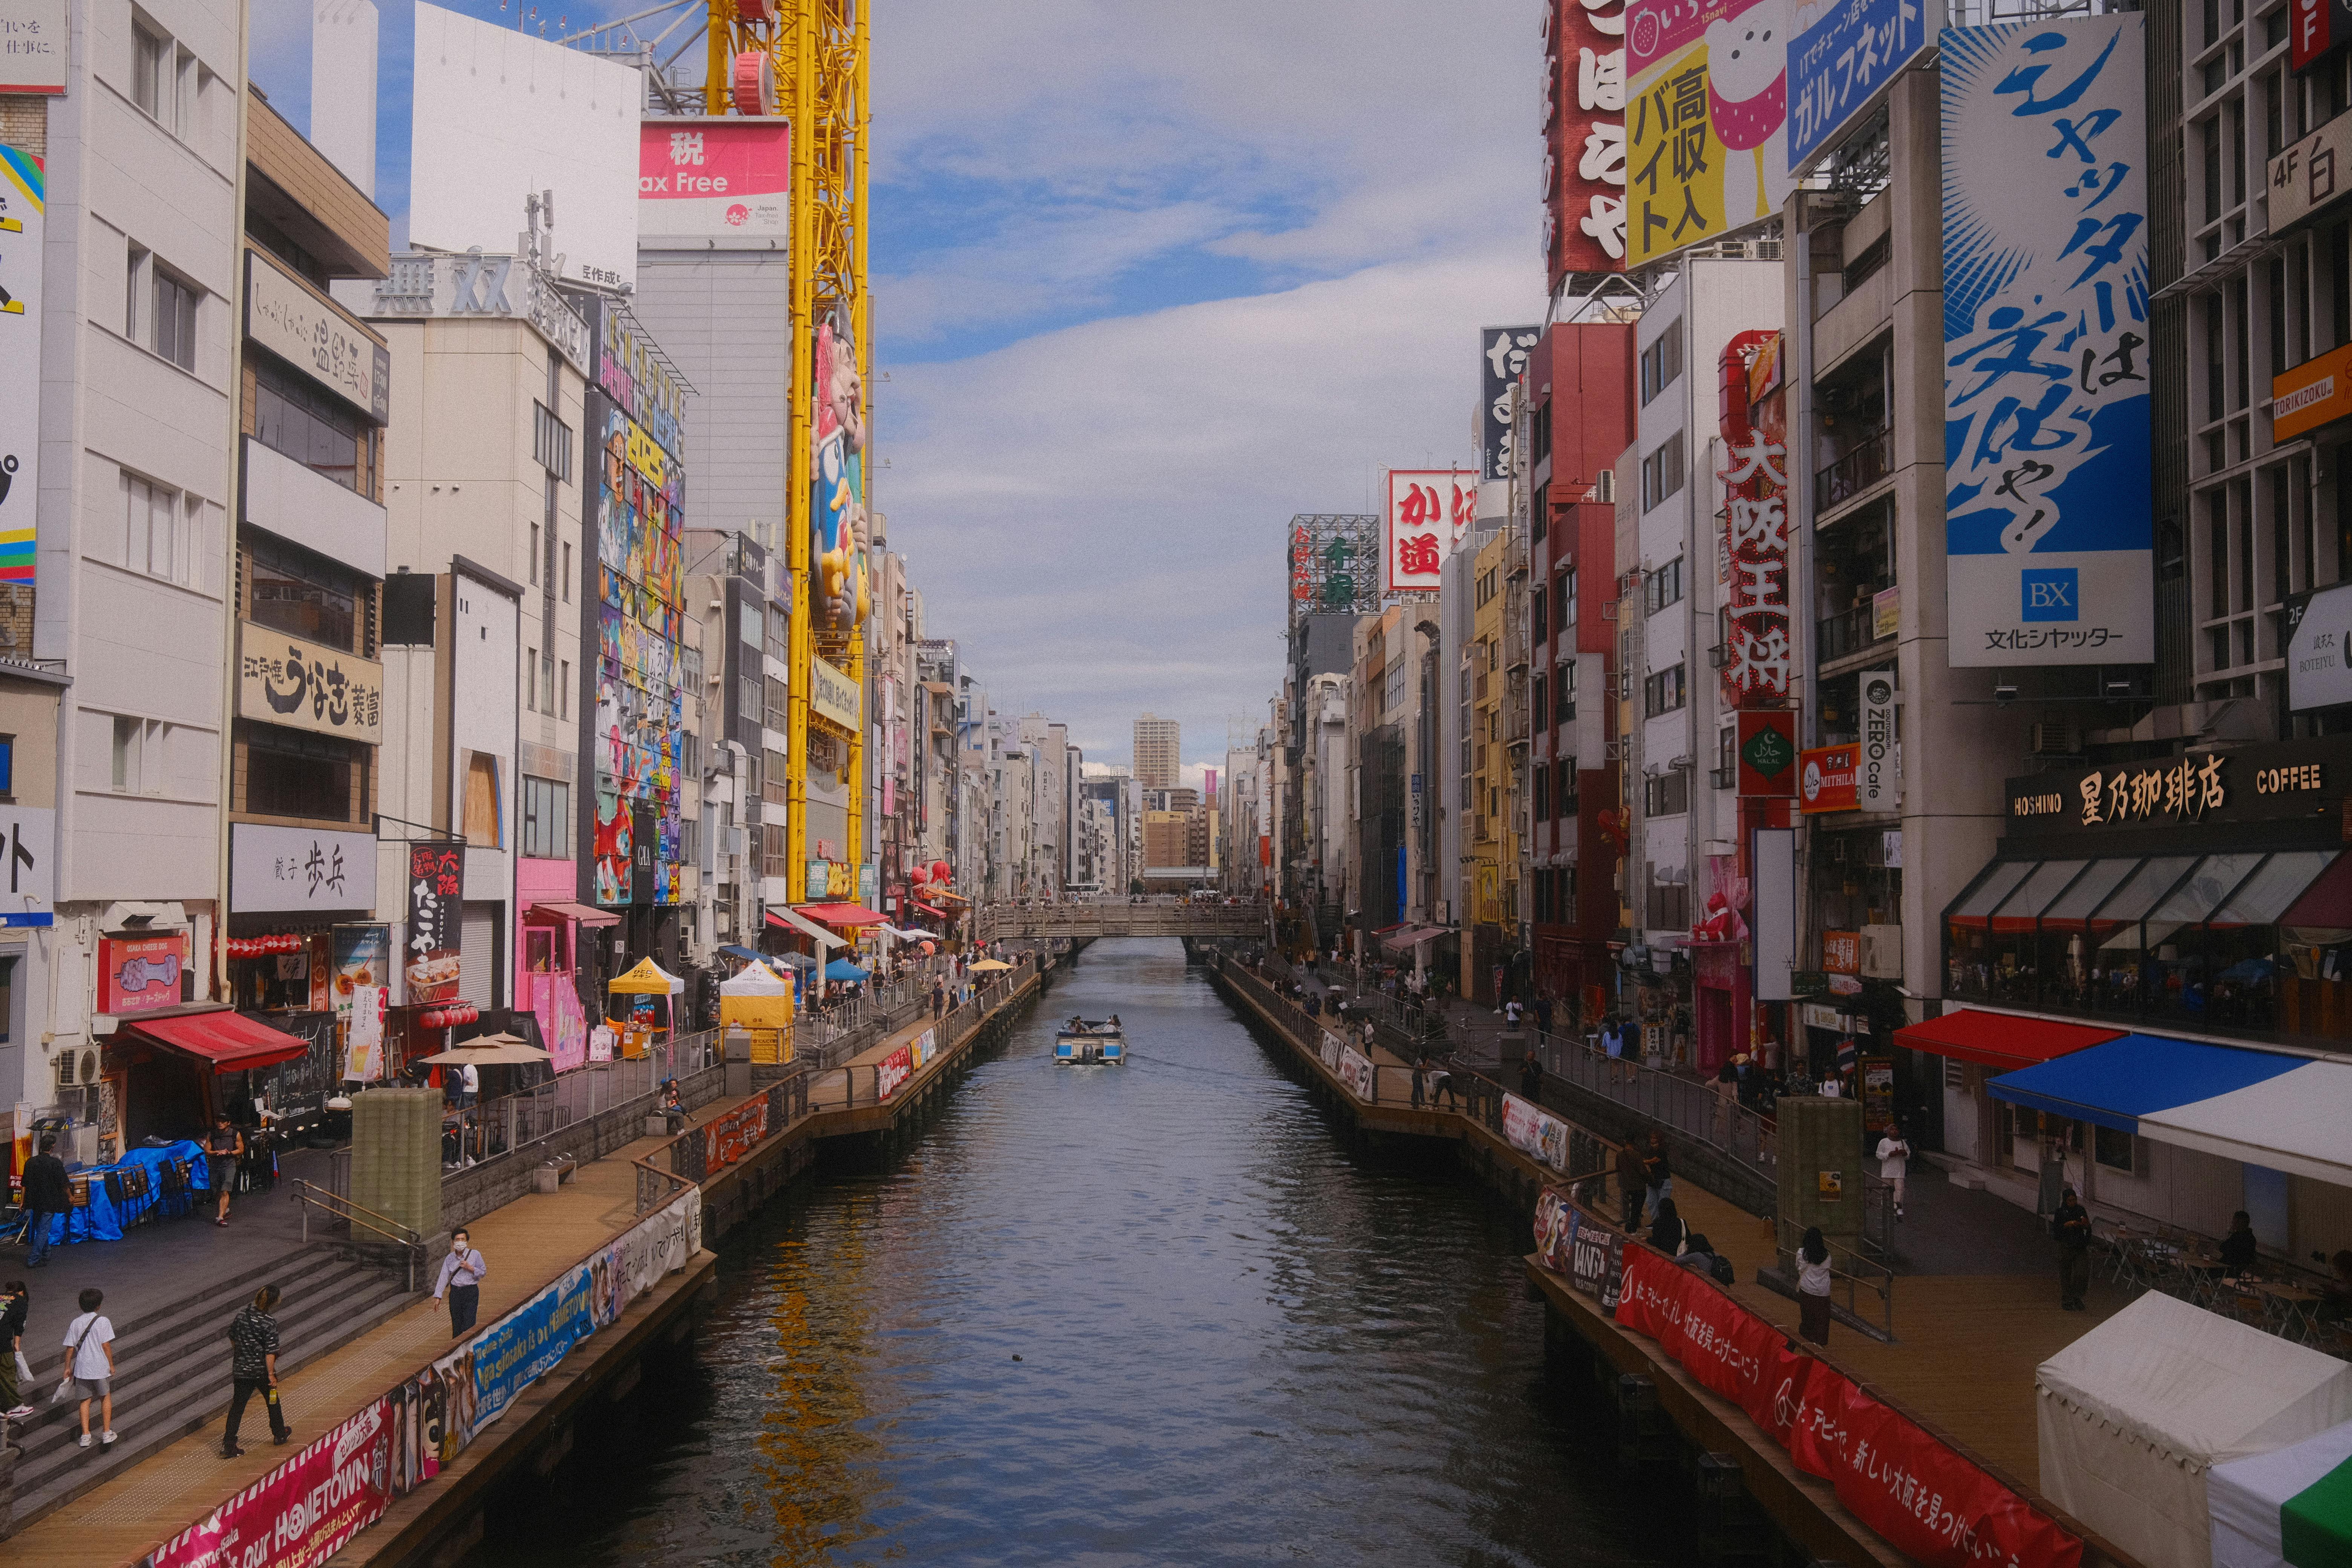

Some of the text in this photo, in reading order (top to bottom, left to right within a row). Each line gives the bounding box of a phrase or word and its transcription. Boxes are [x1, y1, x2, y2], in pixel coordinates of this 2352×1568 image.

[1701, 4, 1727, 24] 15navi
[6, 40, 56, 55] 仕事に。
[1795, 0, 1917, 151] ガルフネット
[671, 132, 704, 165] 税
[677, 172, 727, 191] Free
[1634, 81, 1670, 254] バイト
[2274, 150, 2298, 188] 4F
[2274, 382, 2327, 416] TORIKIZOKU
[1724, 429, 1788, 693] 大阪王将
[2030, 582, 2072, 607] BX
[2289, 606, 2302, 626] 2F
[1821, 774, 1855, 787] MITHILA
[2080, 754, 2225, 825] 星乃珈琲店
[2257, 764, 2320, 794] COFFEE
[2014, 793, 2062, 816] HOSHINO
[274, 840, 345, 898] 餃子 歩兵
[437, 850, 459, 896] 大阪
[411, 879, 438, 979] たこやき
[341, 1420, 373, 1457] セレッソ大阪
